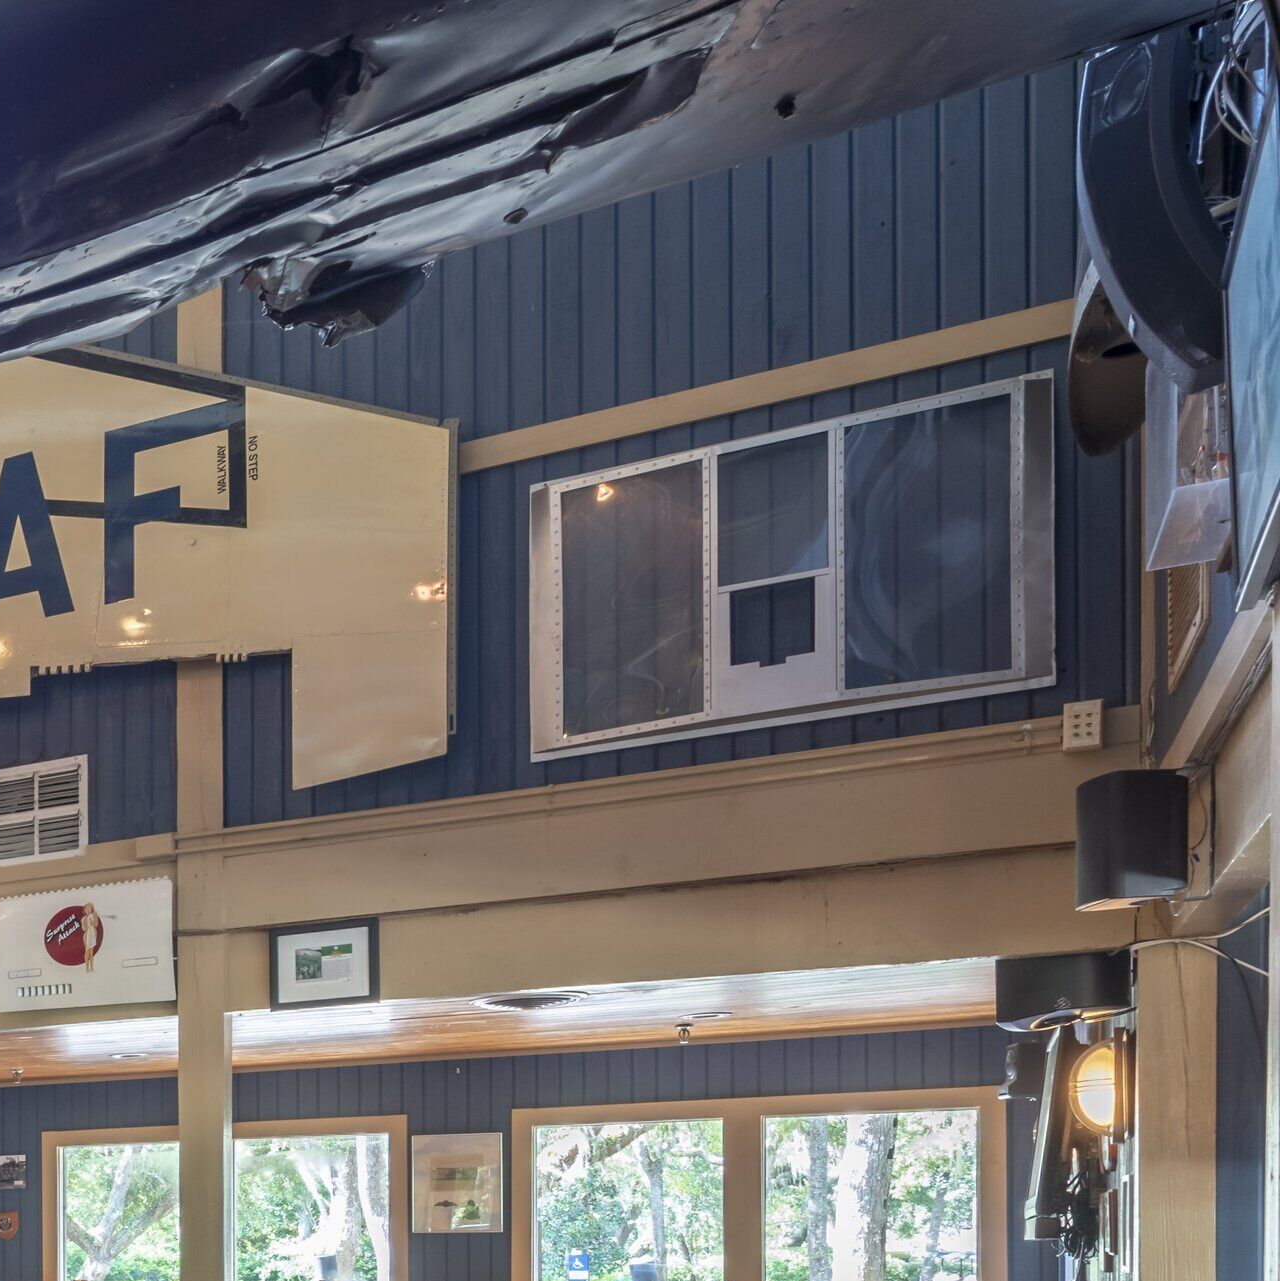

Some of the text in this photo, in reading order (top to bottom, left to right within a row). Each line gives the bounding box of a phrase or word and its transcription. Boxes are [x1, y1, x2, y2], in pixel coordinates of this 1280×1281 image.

[216, 445, 227, 495] WALKWAY
[248, 435, 259, 481] NO STEP
[46, 914, 76, 943] Surprise
[58, 921, 80, 945] Attack
